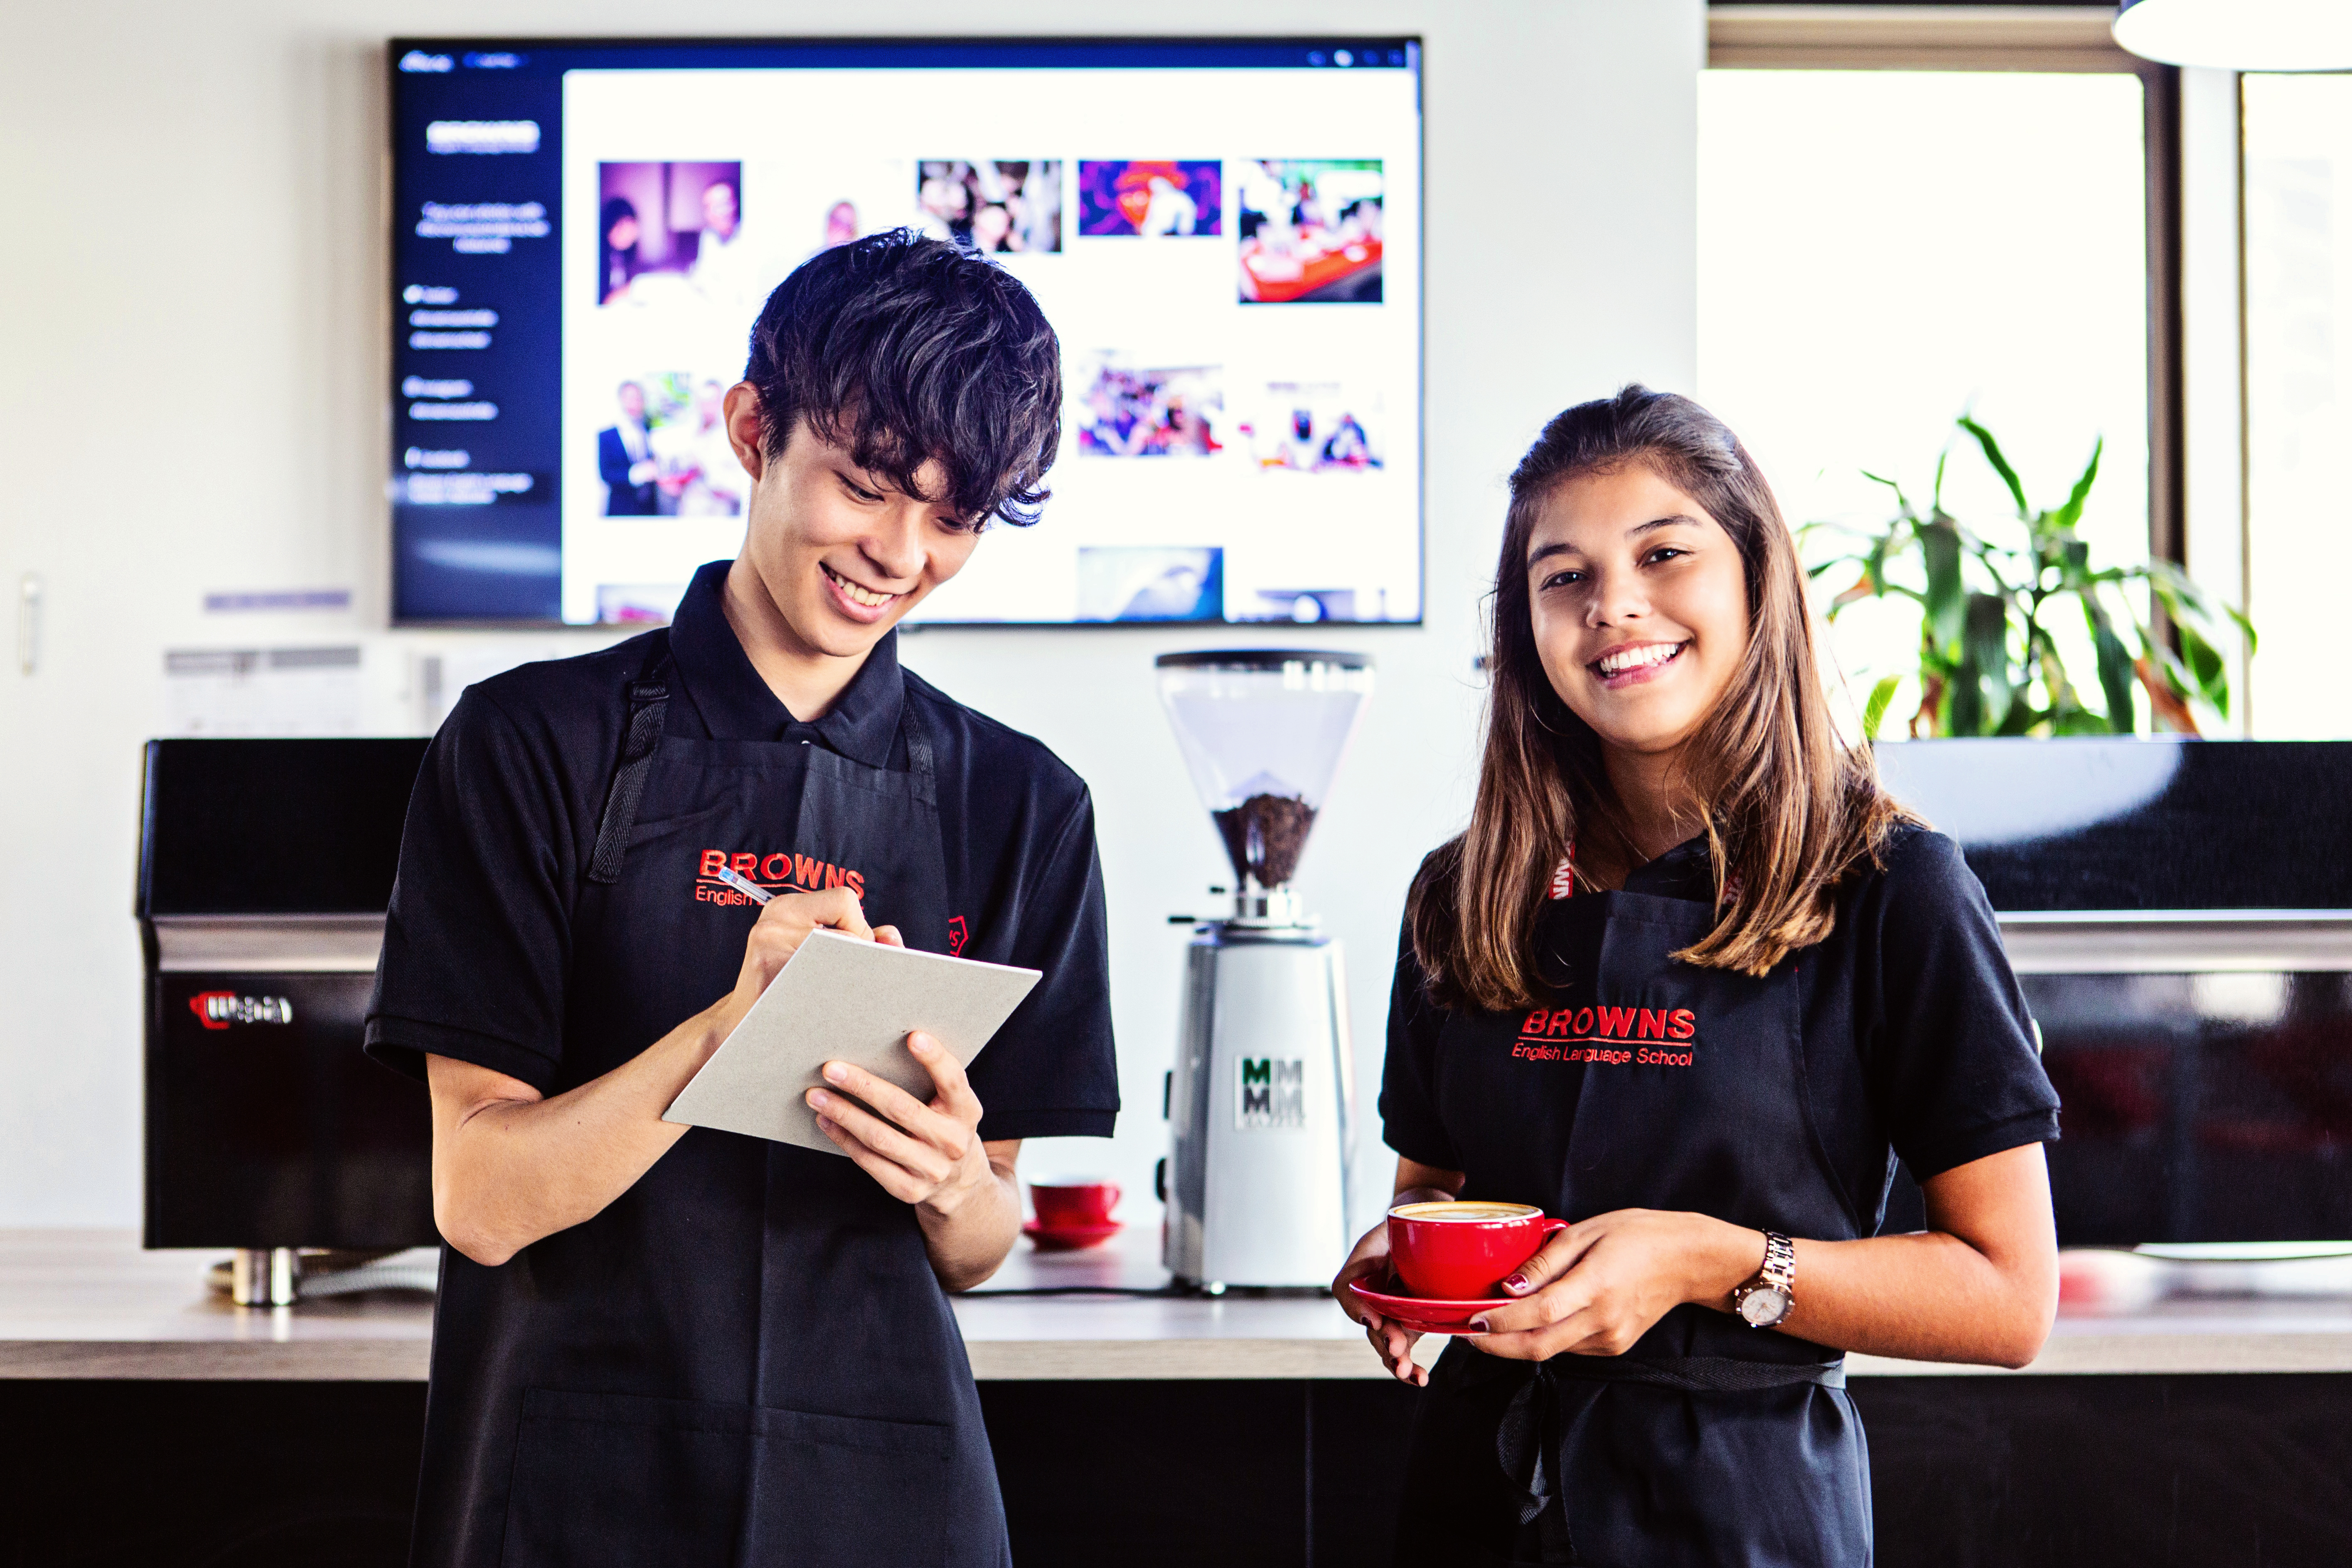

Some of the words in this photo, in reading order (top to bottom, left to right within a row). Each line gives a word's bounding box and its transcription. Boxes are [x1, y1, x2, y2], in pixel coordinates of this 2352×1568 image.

[699, 849, 864, 900] BROWNS
[695, 885, 753, 906] English
[1521, 1005, 1695, 1039] BROWNS
[1511, 1042, 1560, 1061] English
[1563, 1046, 1632, 1065] Language
[1636, 1048, 1693, 1066] School
